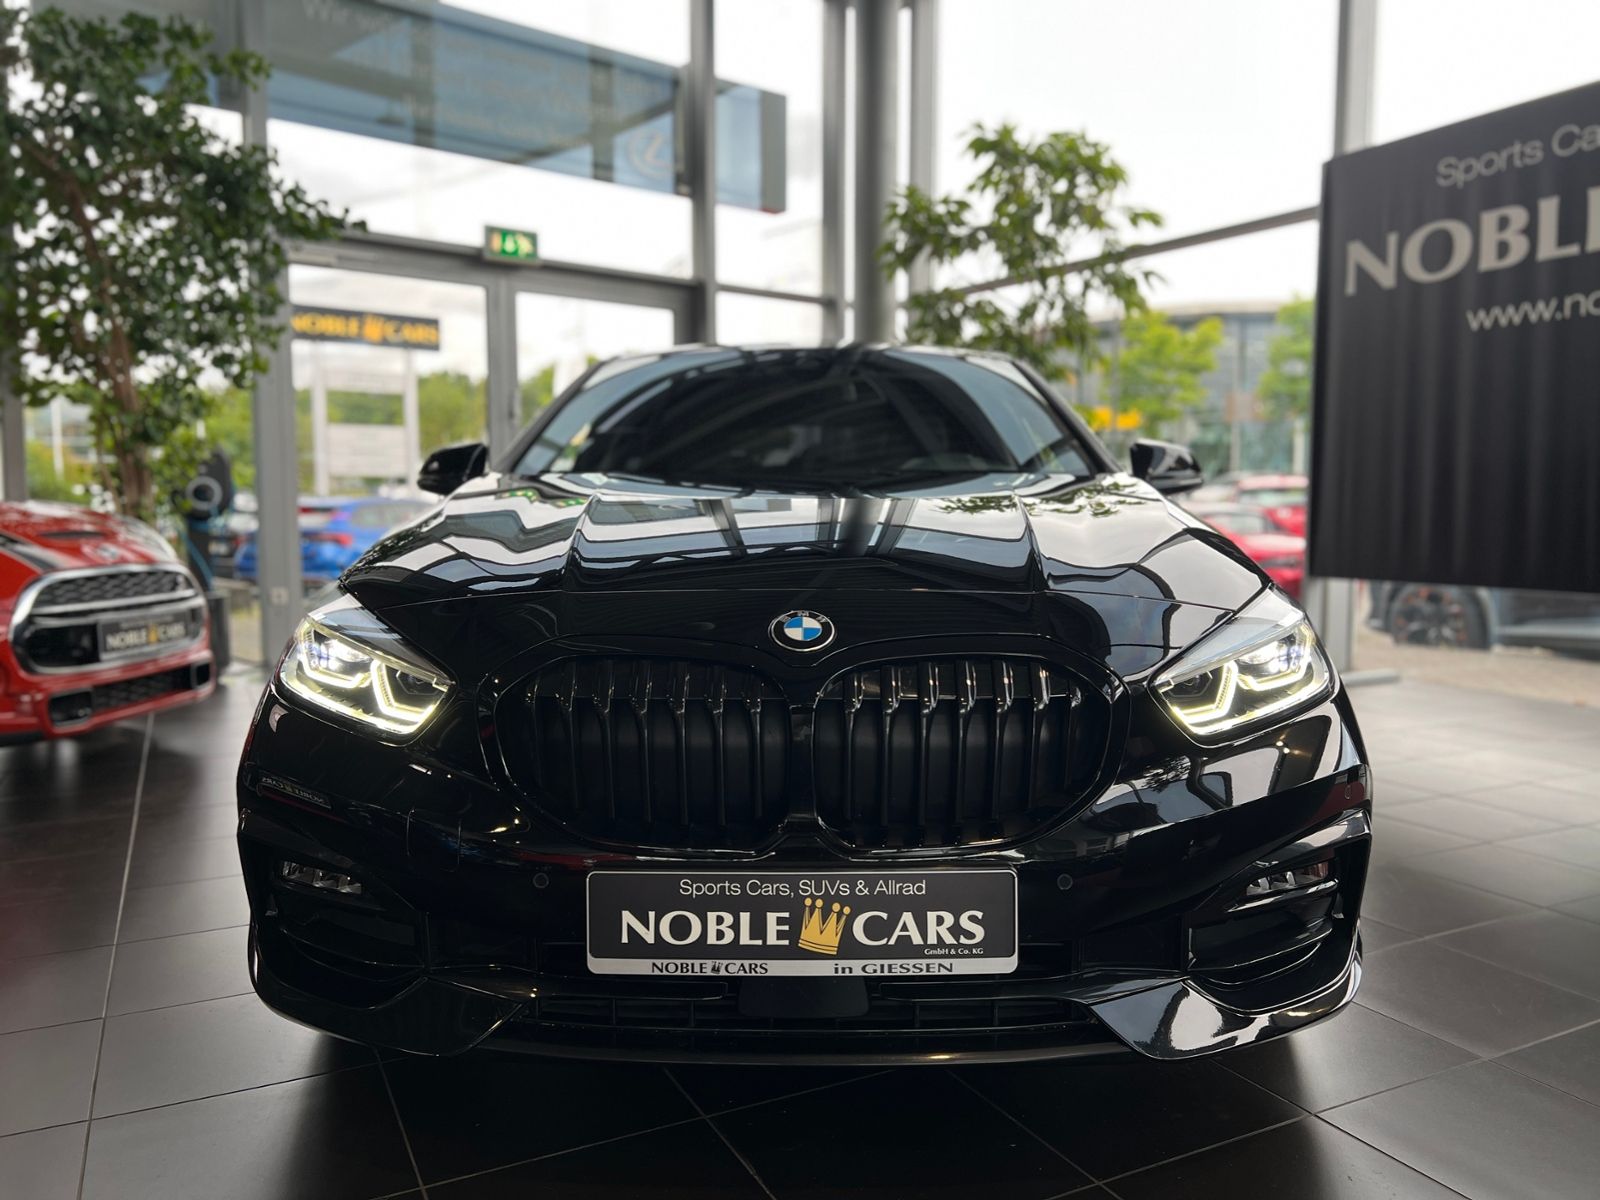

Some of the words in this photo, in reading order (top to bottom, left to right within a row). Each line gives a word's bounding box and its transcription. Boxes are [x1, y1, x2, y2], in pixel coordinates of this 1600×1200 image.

[1436, 139, 1544, 189] Sports
[106, 626, 147, 650] NOBLE
[679, 879, 741, 899] Sports
[746, 879, 794, 898] Cars,
[798, 879, 850, 896] SUVs
[855, 880, 870, 896] &
[874, 879, 926, 896] Allrad
[621, 910, 790, 946] NOBLE
[852, 910, 985, 946] CARS
[924, 948, 949, 956] GmbH
[972, 947, 984, 955] KG
[651, 961, 708, 974] NOBLE
[724, 962, 768, 975] CARS
[834, 963, 853, 974] in
[861, 962, 953, 974] GIESSEN
